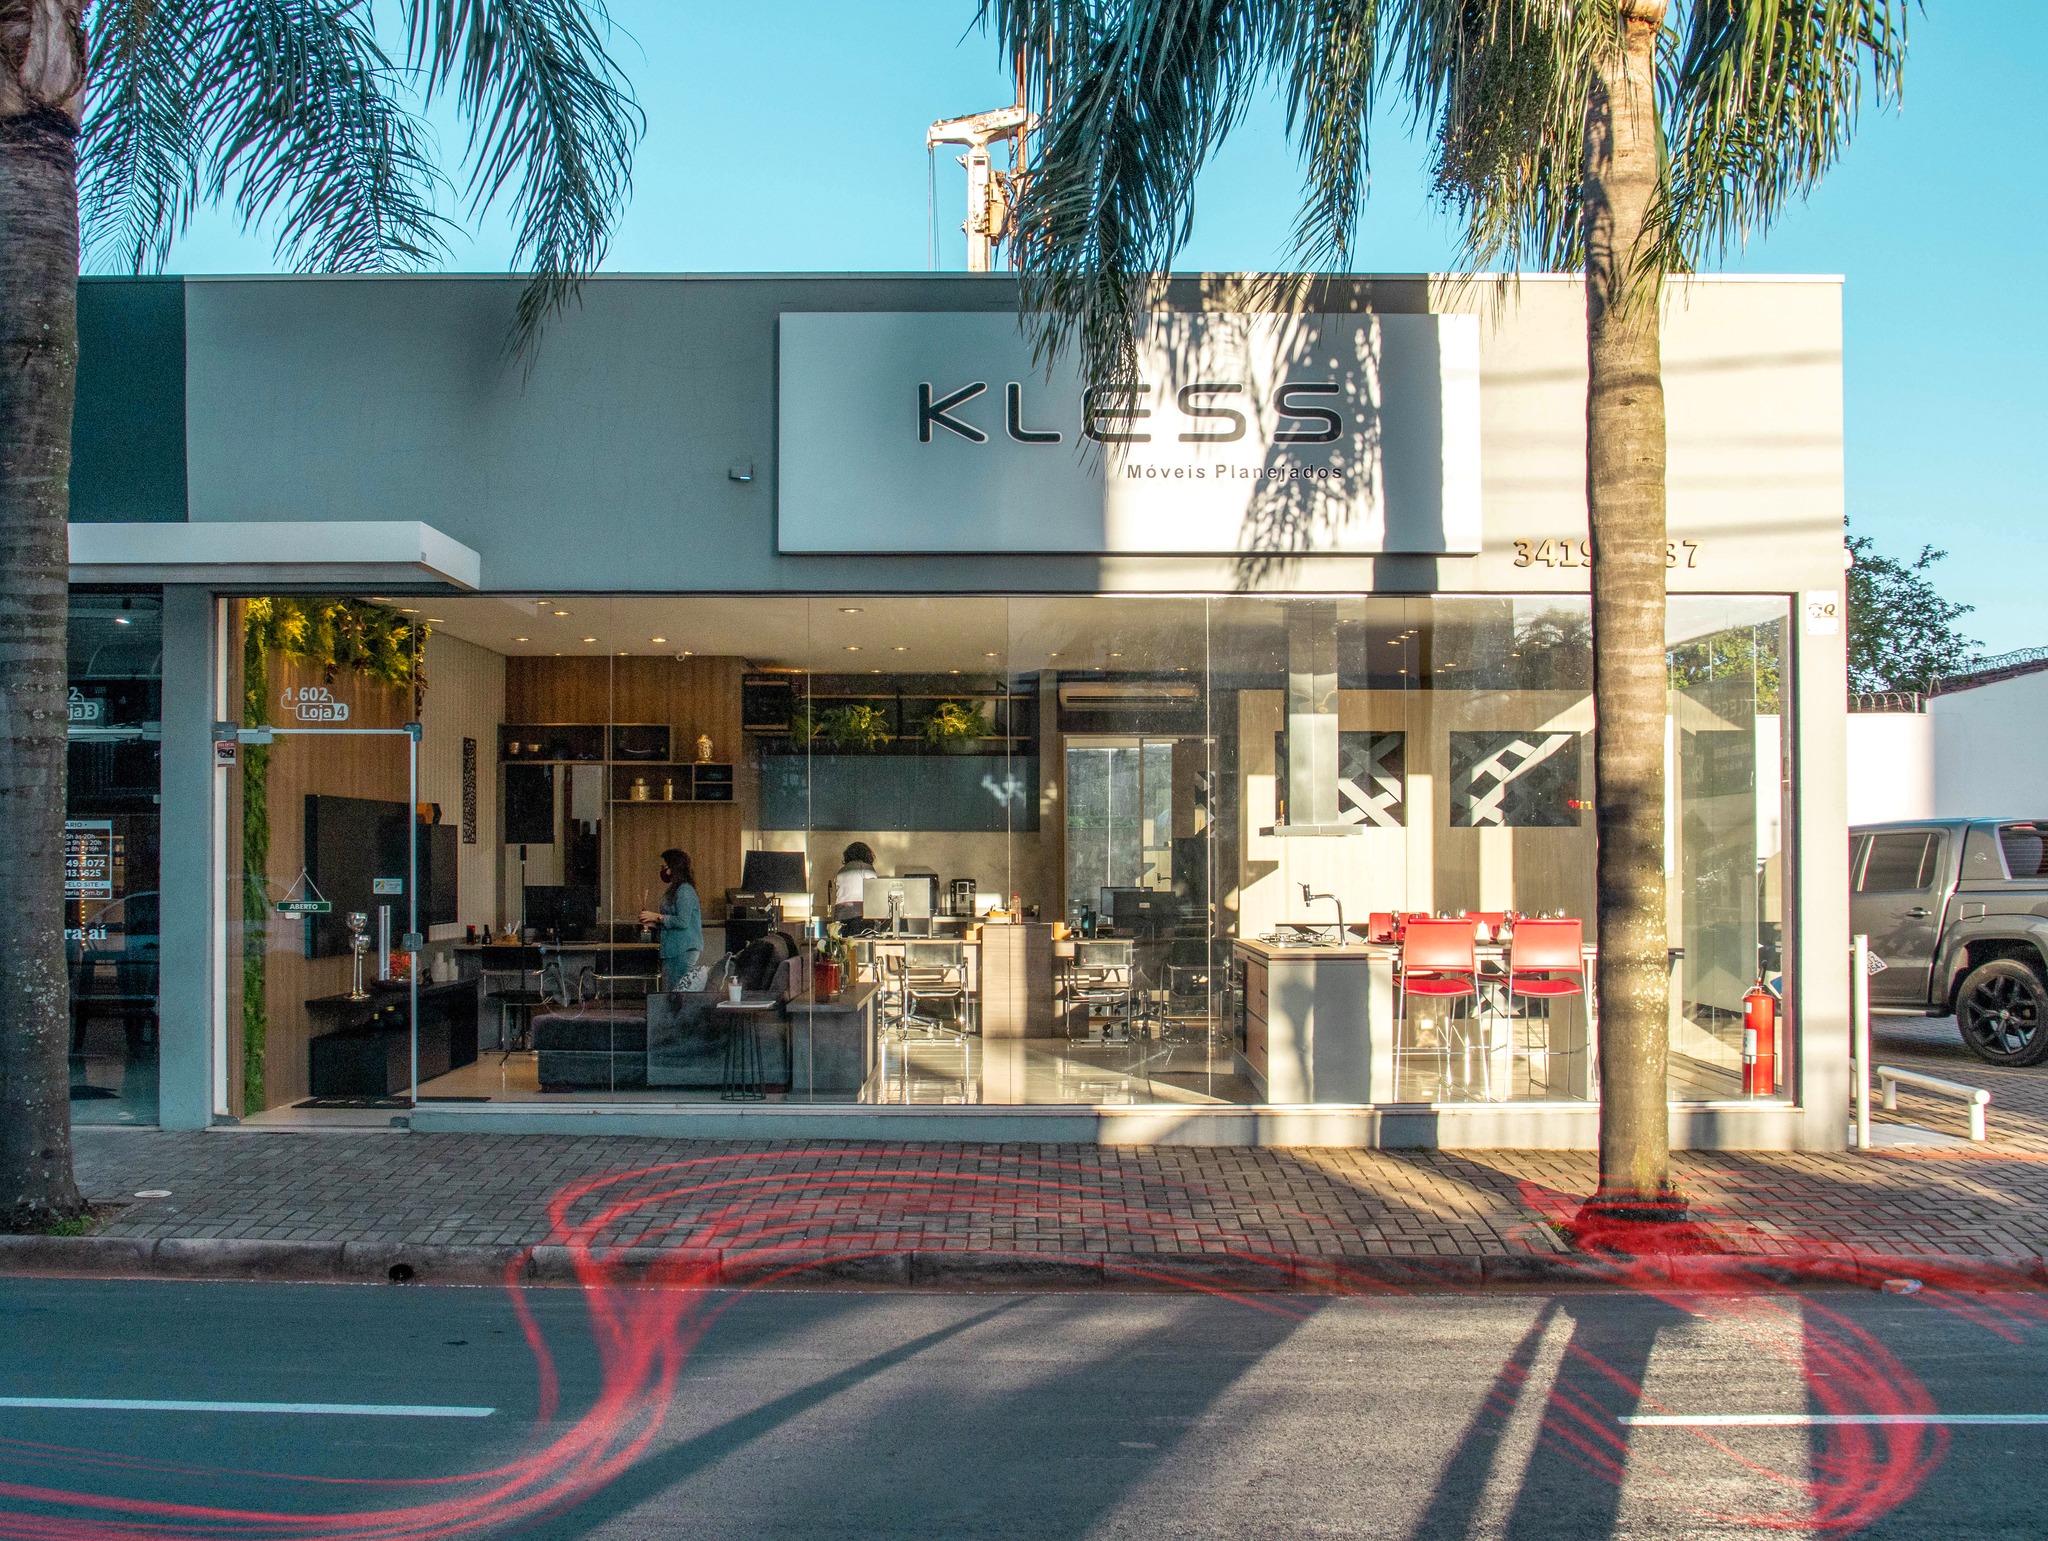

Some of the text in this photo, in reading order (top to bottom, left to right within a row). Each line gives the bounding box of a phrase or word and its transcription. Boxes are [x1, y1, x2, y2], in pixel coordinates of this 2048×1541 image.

[918, 382, 1343, 443] KLESS
[1127, 464, 1342, 482] Móveis Planejados
[285, 687, 328, 701] 1.602
[88, 705, 95, 717] 3
[302, 705, 345, 721] Loja 4
